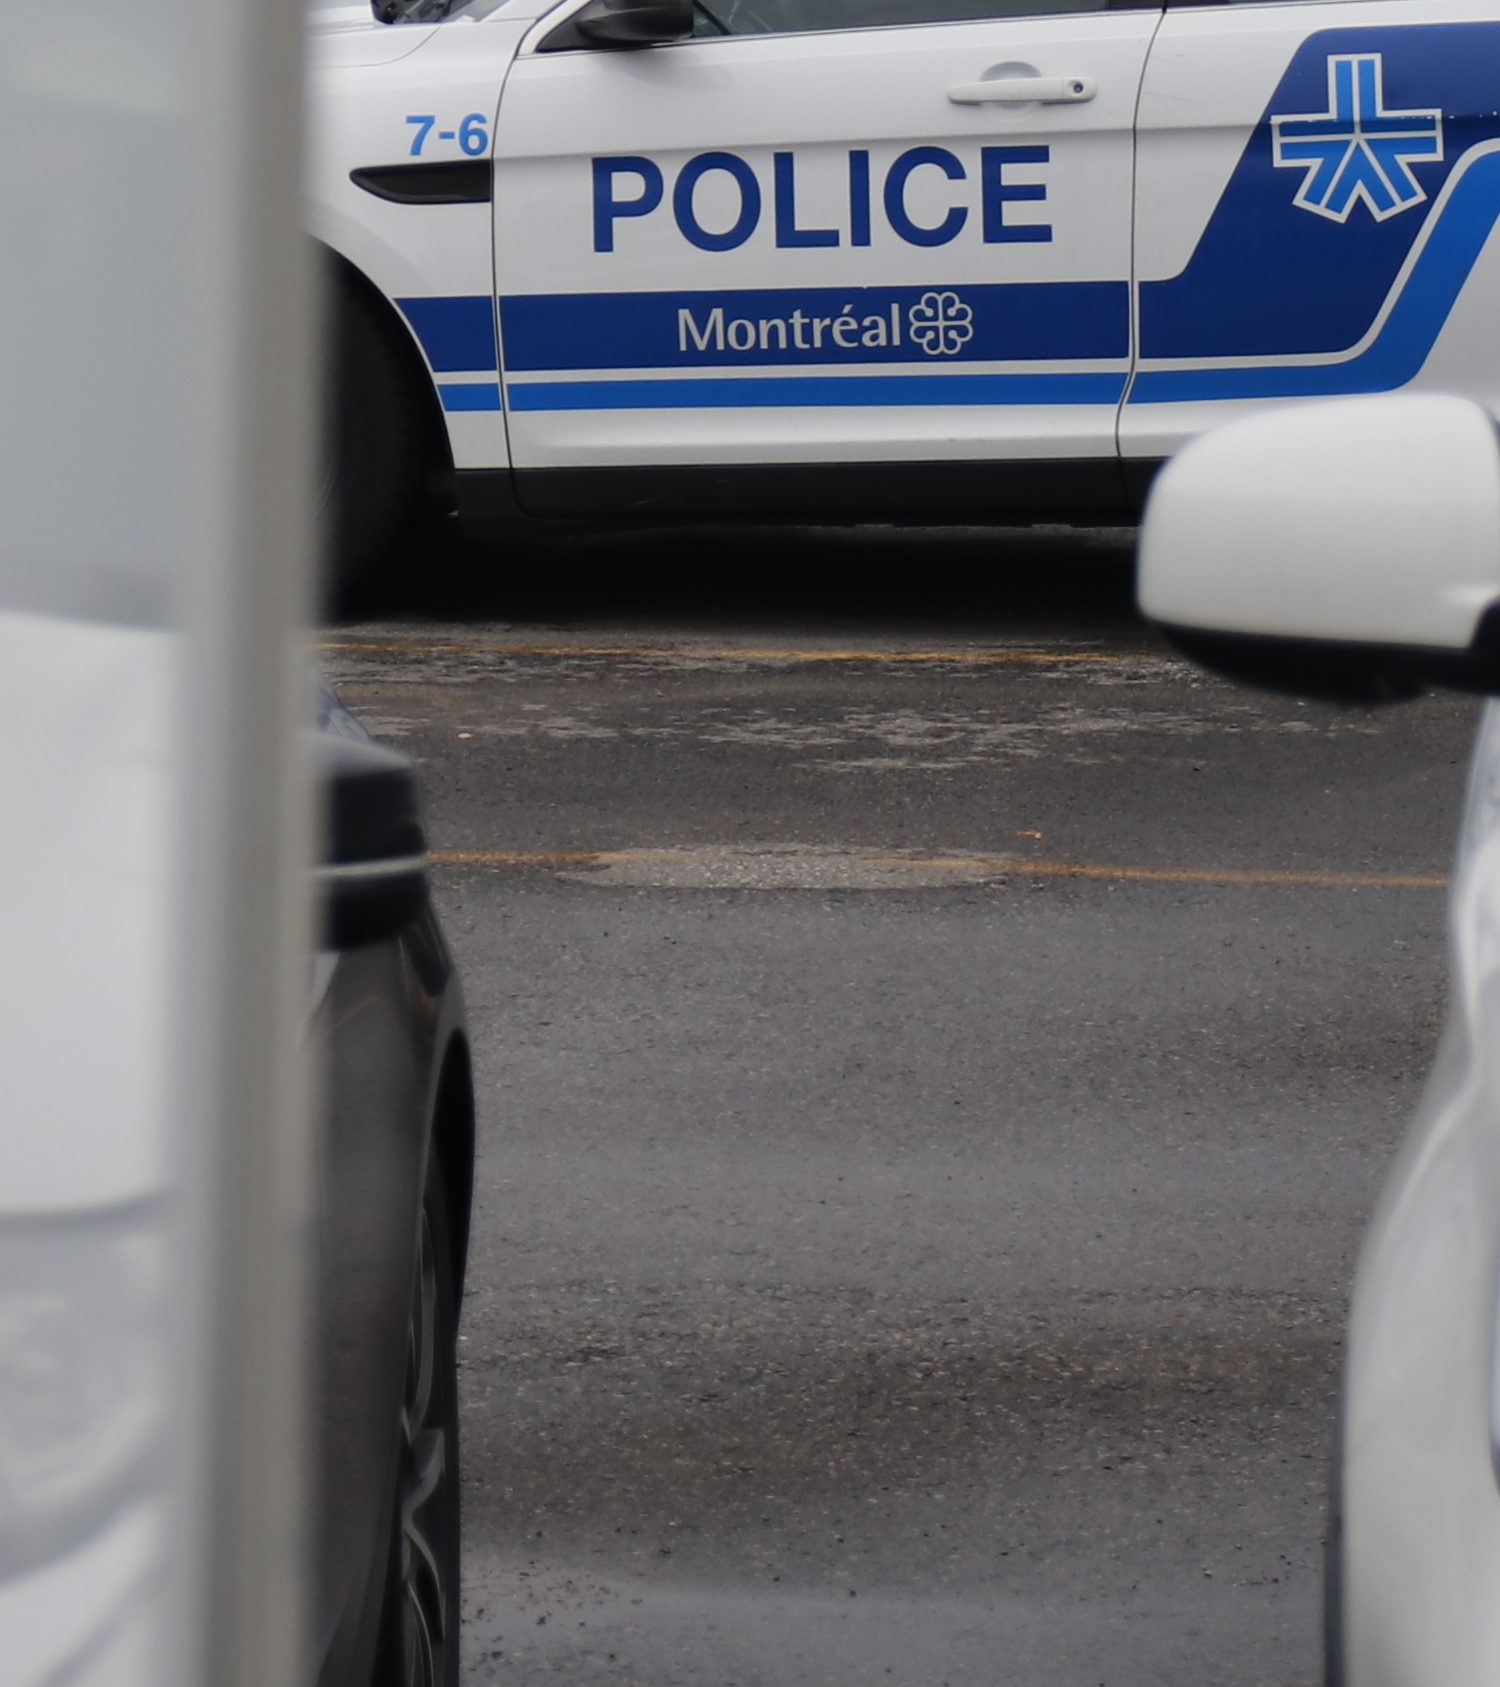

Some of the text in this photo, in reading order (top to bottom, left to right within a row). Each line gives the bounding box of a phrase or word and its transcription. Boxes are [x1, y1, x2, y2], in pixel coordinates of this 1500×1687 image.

[405, 113, 490, 157] 7-6
[590, 145, 1053, 253] POLICE
[677, 303, 901, 353] Montréal
